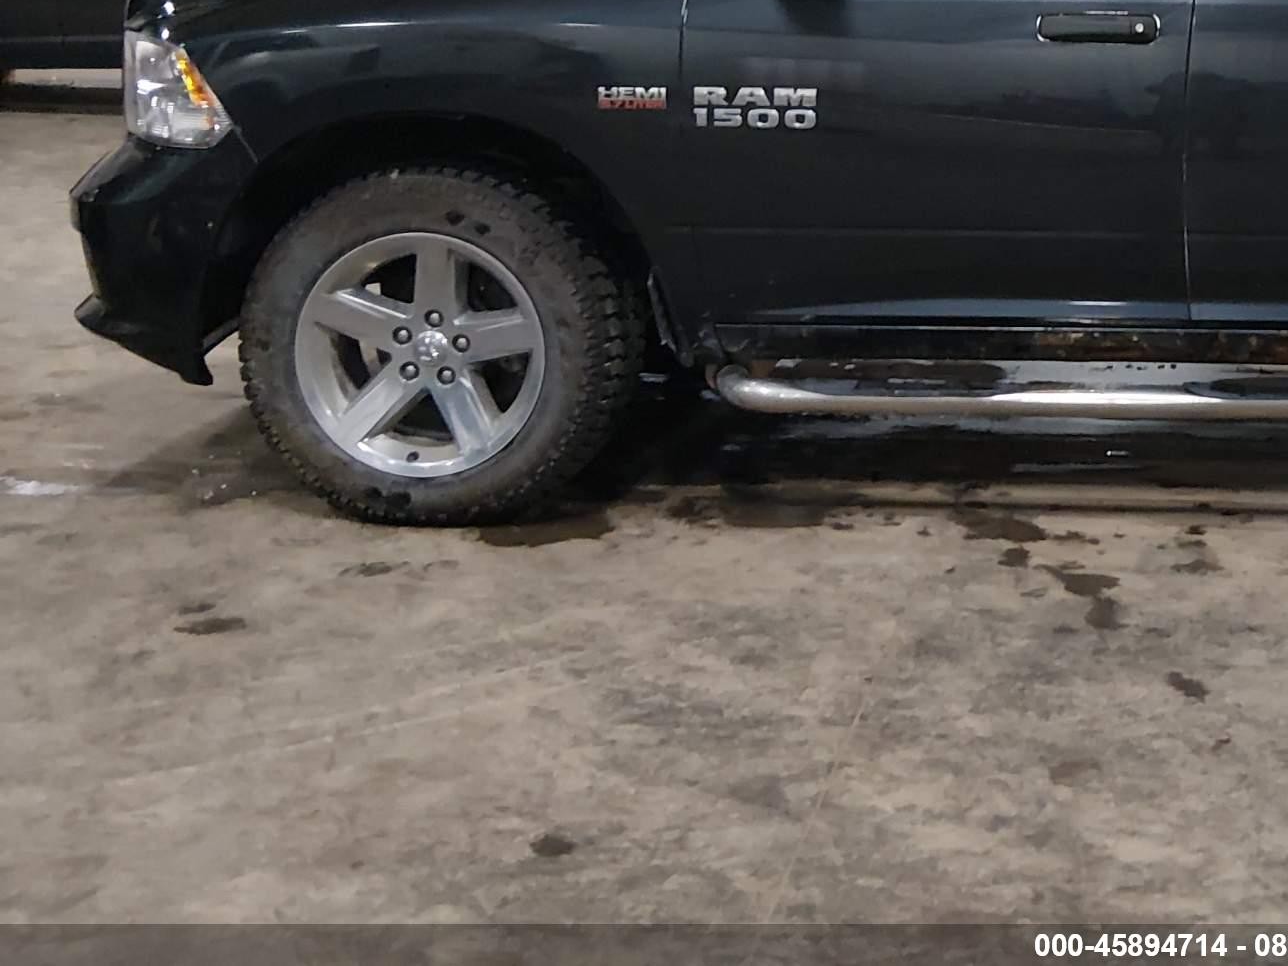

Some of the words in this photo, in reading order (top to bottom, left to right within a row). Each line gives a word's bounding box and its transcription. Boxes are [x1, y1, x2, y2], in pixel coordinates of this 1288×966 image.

[598, 86, 667, 100] HEMI
[693, 86, 818, 106] RAM
[693, 107, 817, 129] 1500
